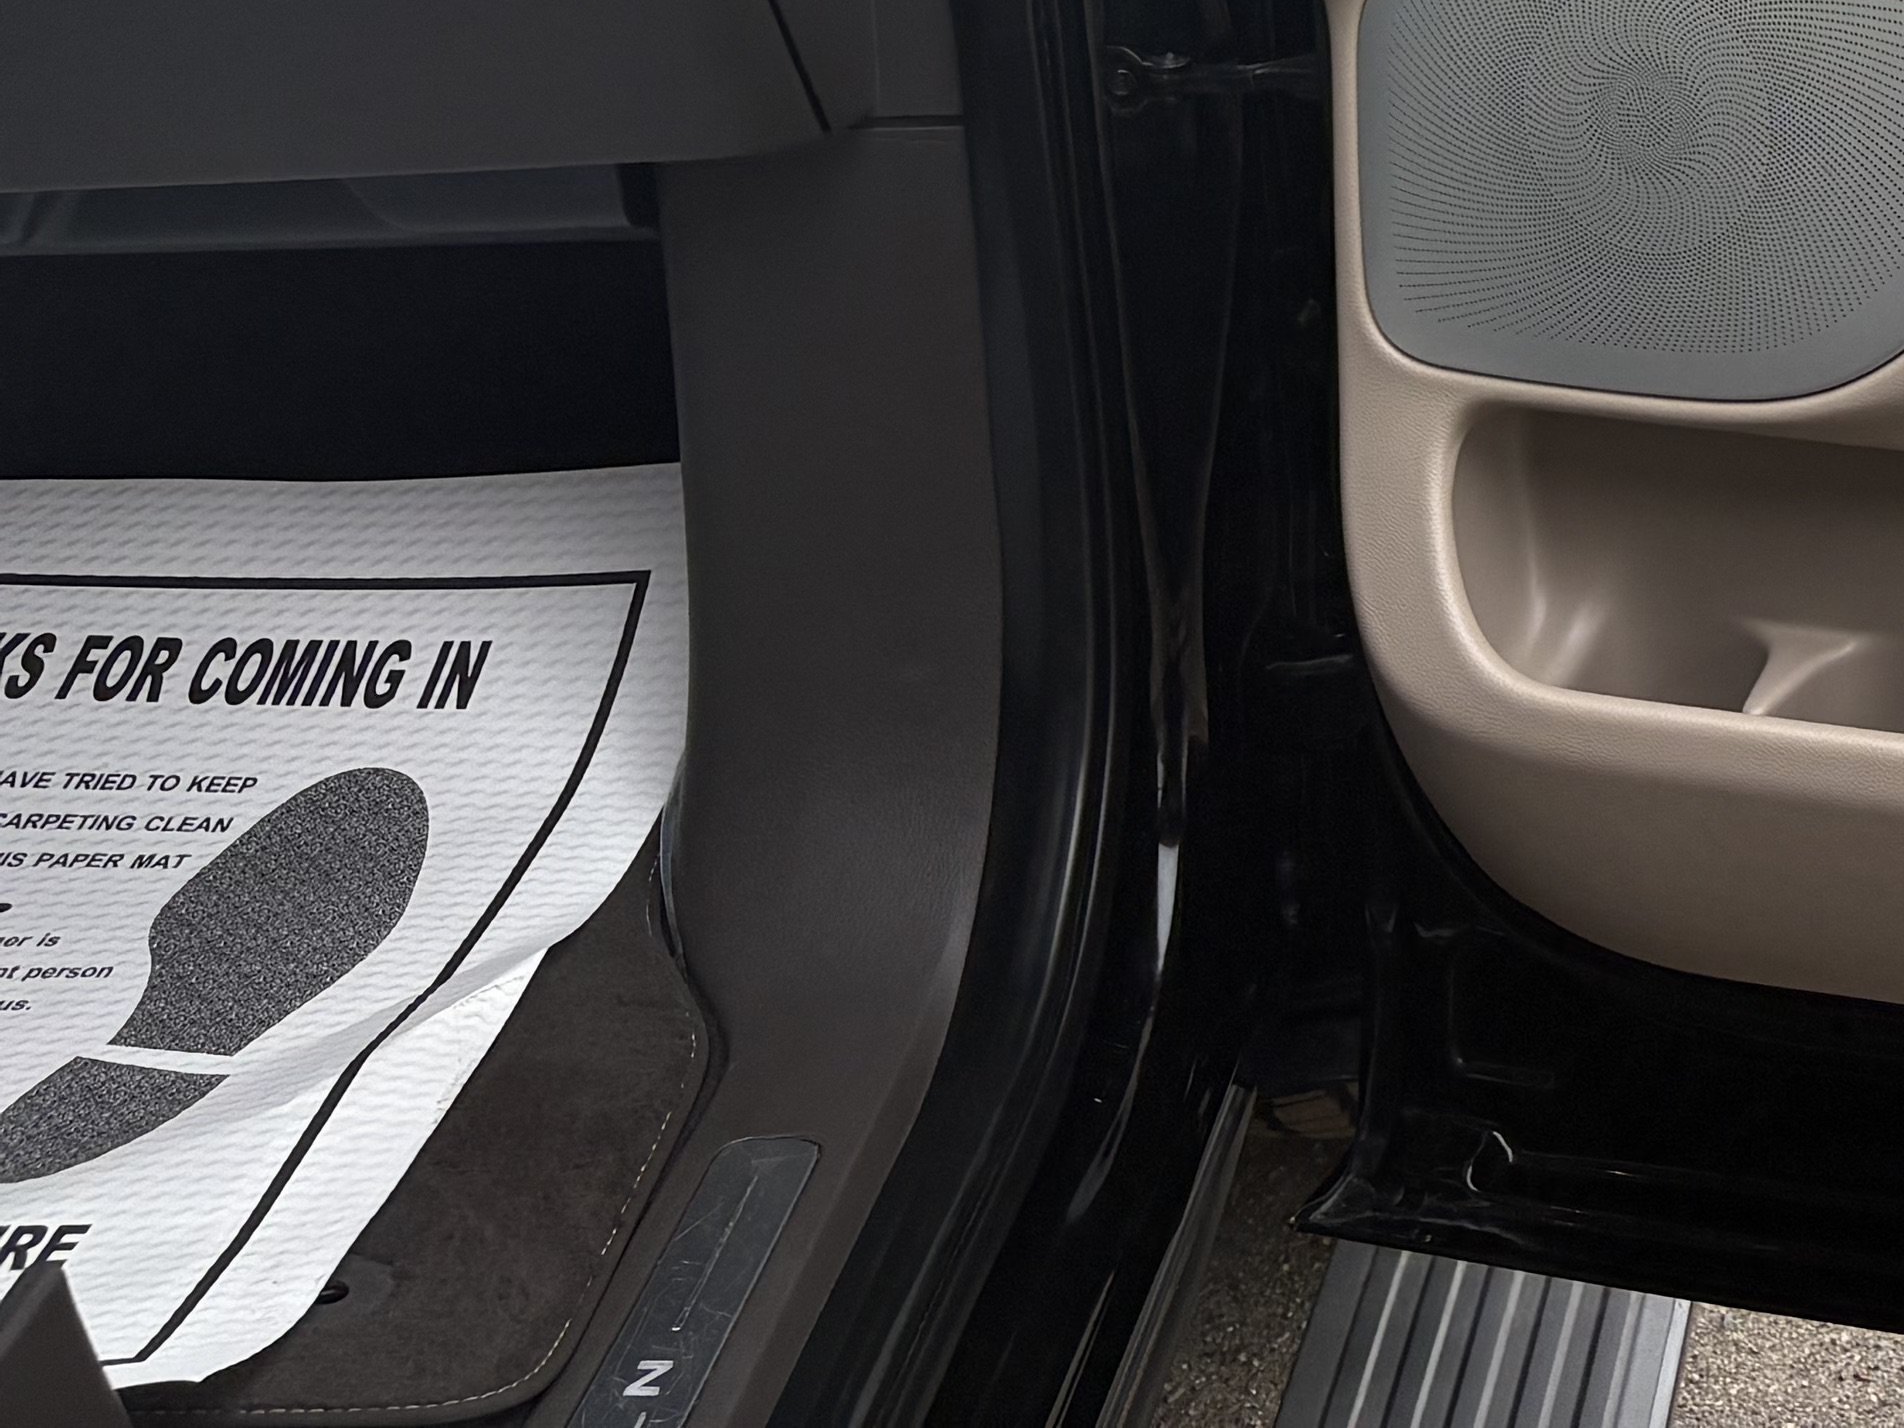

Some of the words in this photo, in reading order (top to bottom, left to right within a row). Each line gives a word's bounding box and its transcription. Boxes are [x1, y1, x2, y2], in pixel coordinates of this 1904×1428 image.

[55, 634, 183, 703] FOR
[187, 637, 413, 709] COMING
[416, 639, 494, 710] IN
[0, 769, 55, 791] AVE
[64, 771, 137, 792] TRIED
[147, 773, 181, 793] TO
[186, 775, 258, 795] KEEP
[144, 815, 234, 834] CLEAN
[32, 852, 124, 869] PAPER
[130, 853, 191, 871] MAT
[36, 932, 61, 948] is
[21, 966, 114, 982] person
[0, 1223, 93, 1271] RE
